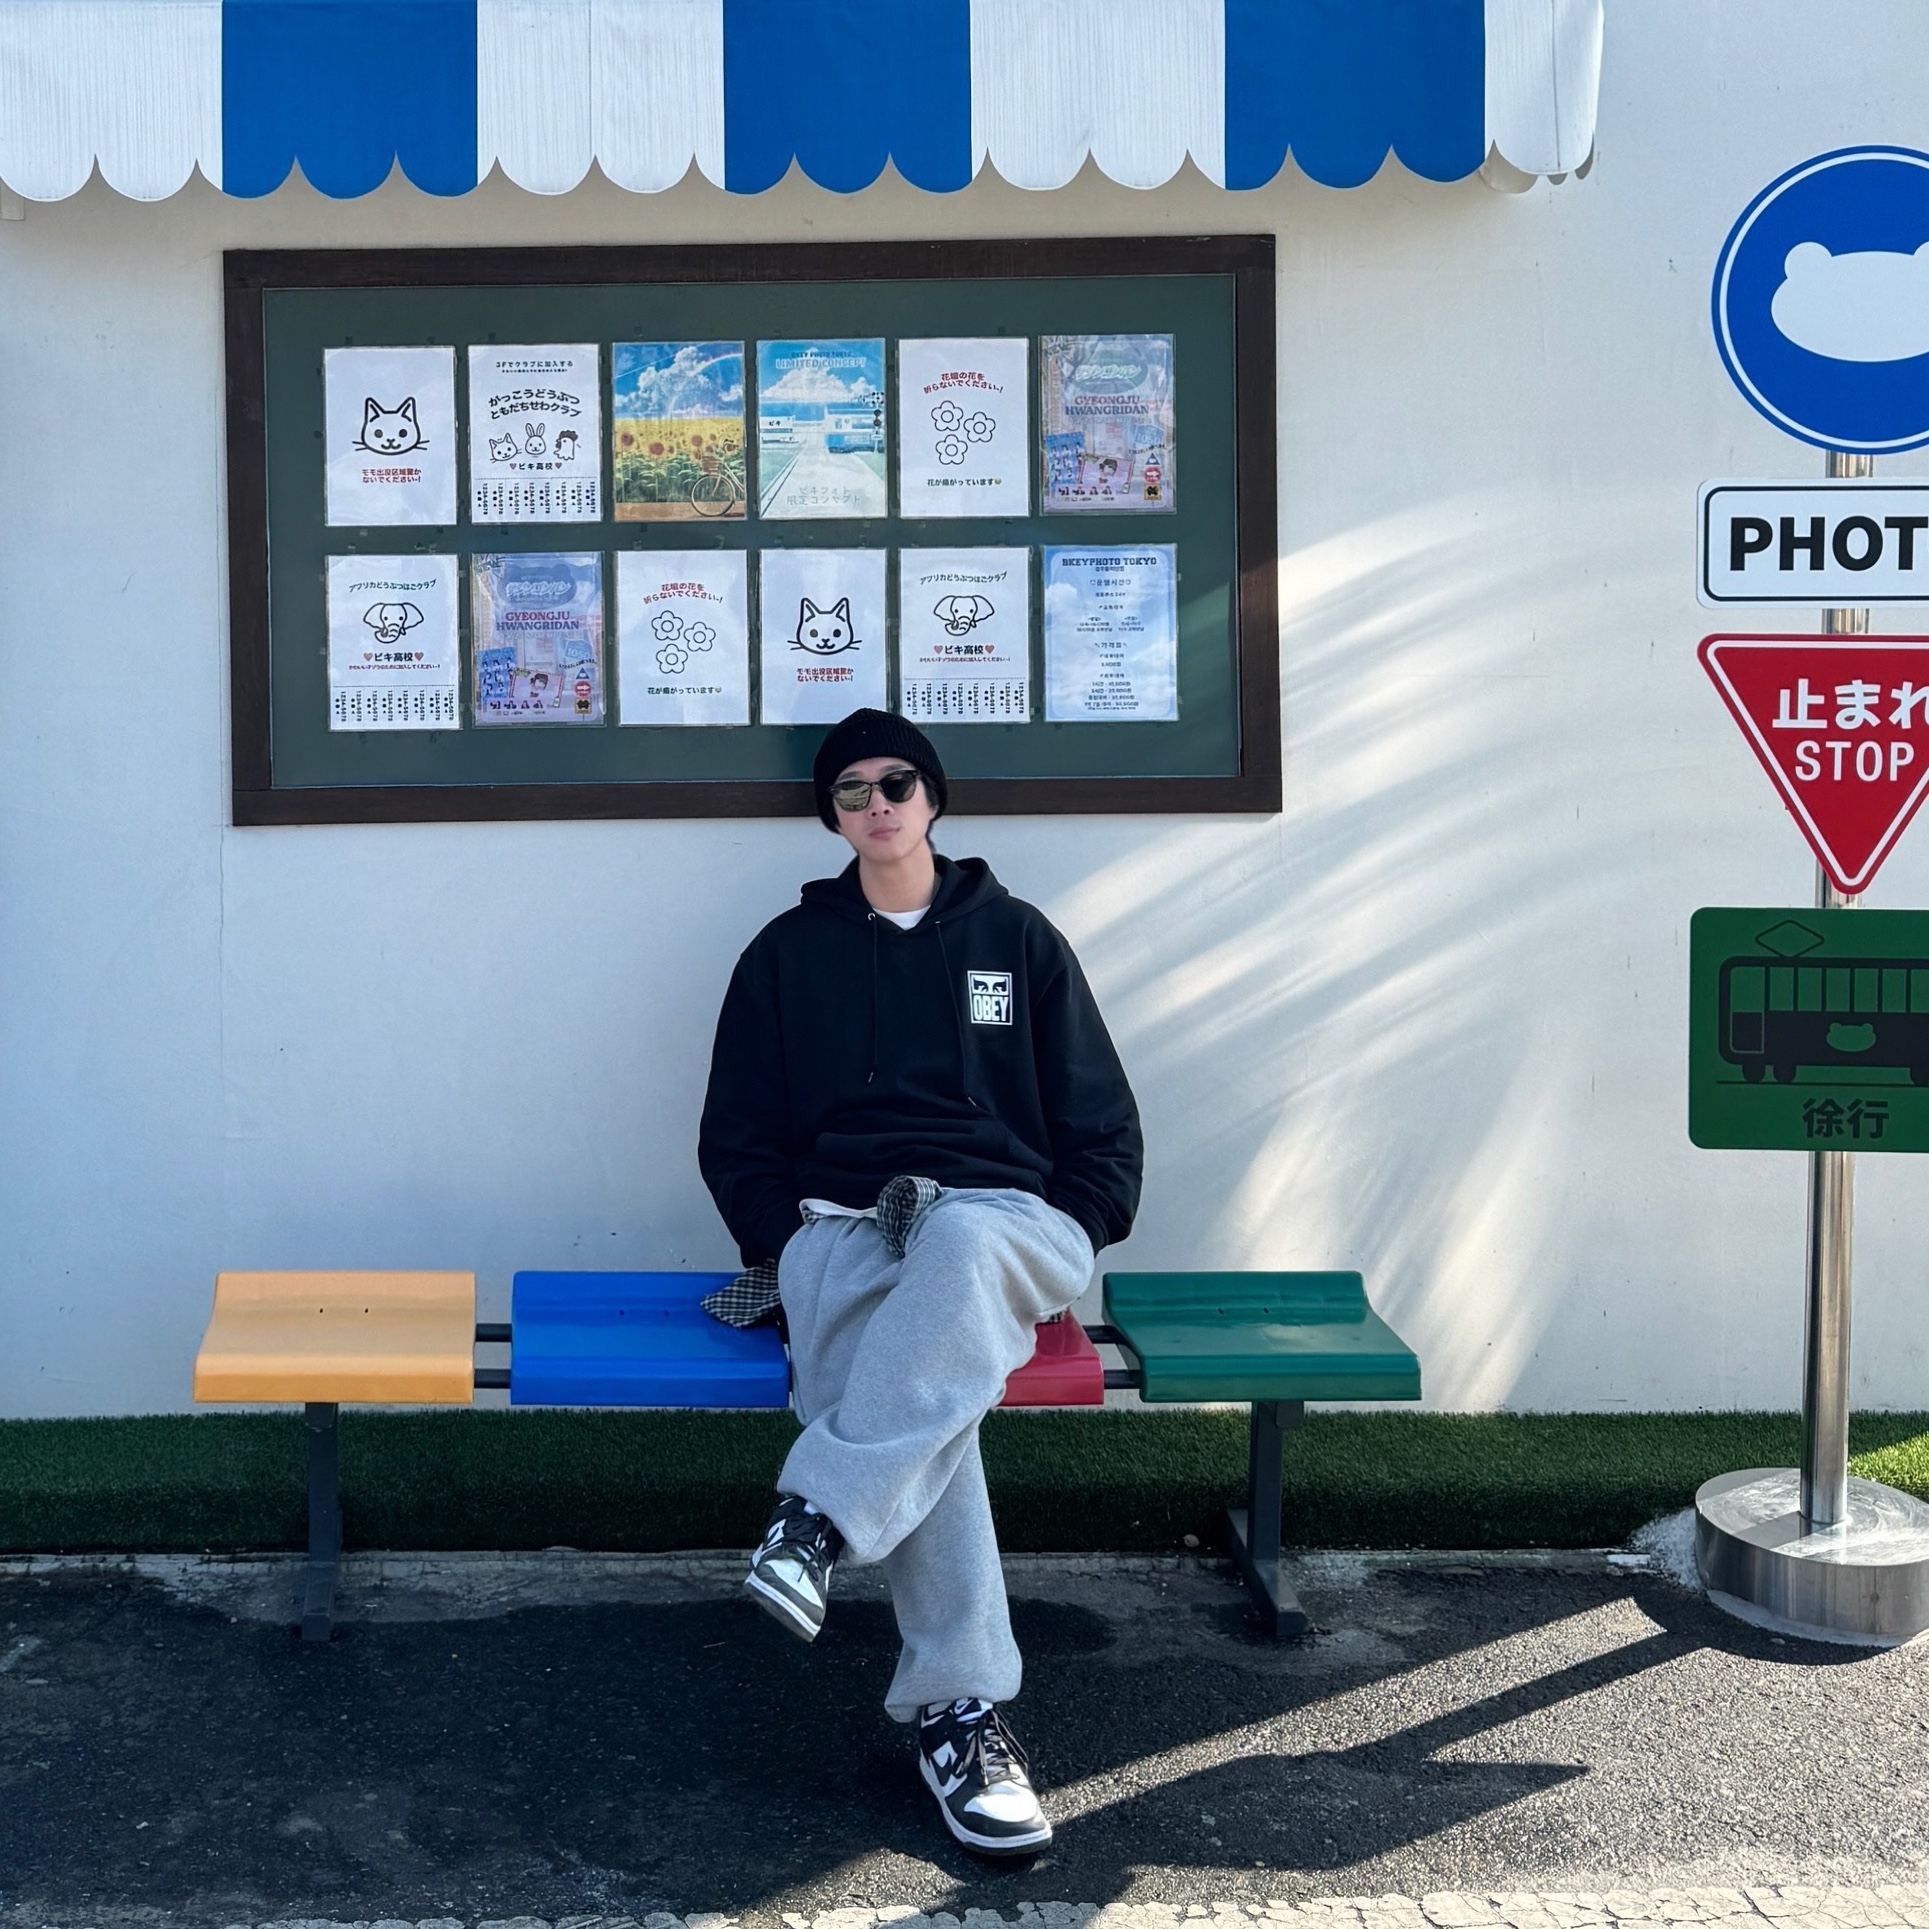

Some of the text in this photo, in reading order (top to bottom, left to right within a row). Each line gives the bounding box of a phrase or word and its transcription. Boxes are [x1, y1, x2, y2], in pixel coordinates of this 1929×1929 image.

[775, 357, 867, 369] LIMITED CONCEPT
[488, 388, 580, 407] がっこうどうぶつ
[1074, 395, 1140, 405] GYEONGJU
[491, 401, 582, 420] ともだちせわクラブ
[1065, 405, 1149, 415] HWANGRIDAN
[519, 462, 553, 470] ビキ高校
[1730, 516, 1928, 571] PHOT
[1062, 557, 1157, 566] BKEYPHOTO TOKYO
[505, 611, 570, 621] GYEONGJU
[496, 621, 579, 631] HWANGRIDAN
[945, 645, 984, 655] ビキ高校
[374, 652, 413, 662] ビキ高校
[1772, 678, 1929, 730] 止まれ
[1795, 740, 1915, 782] STOP
[973, 994, 1009, 1022] OBEY
[1802, 1098, 1890, 1138] 徐行
